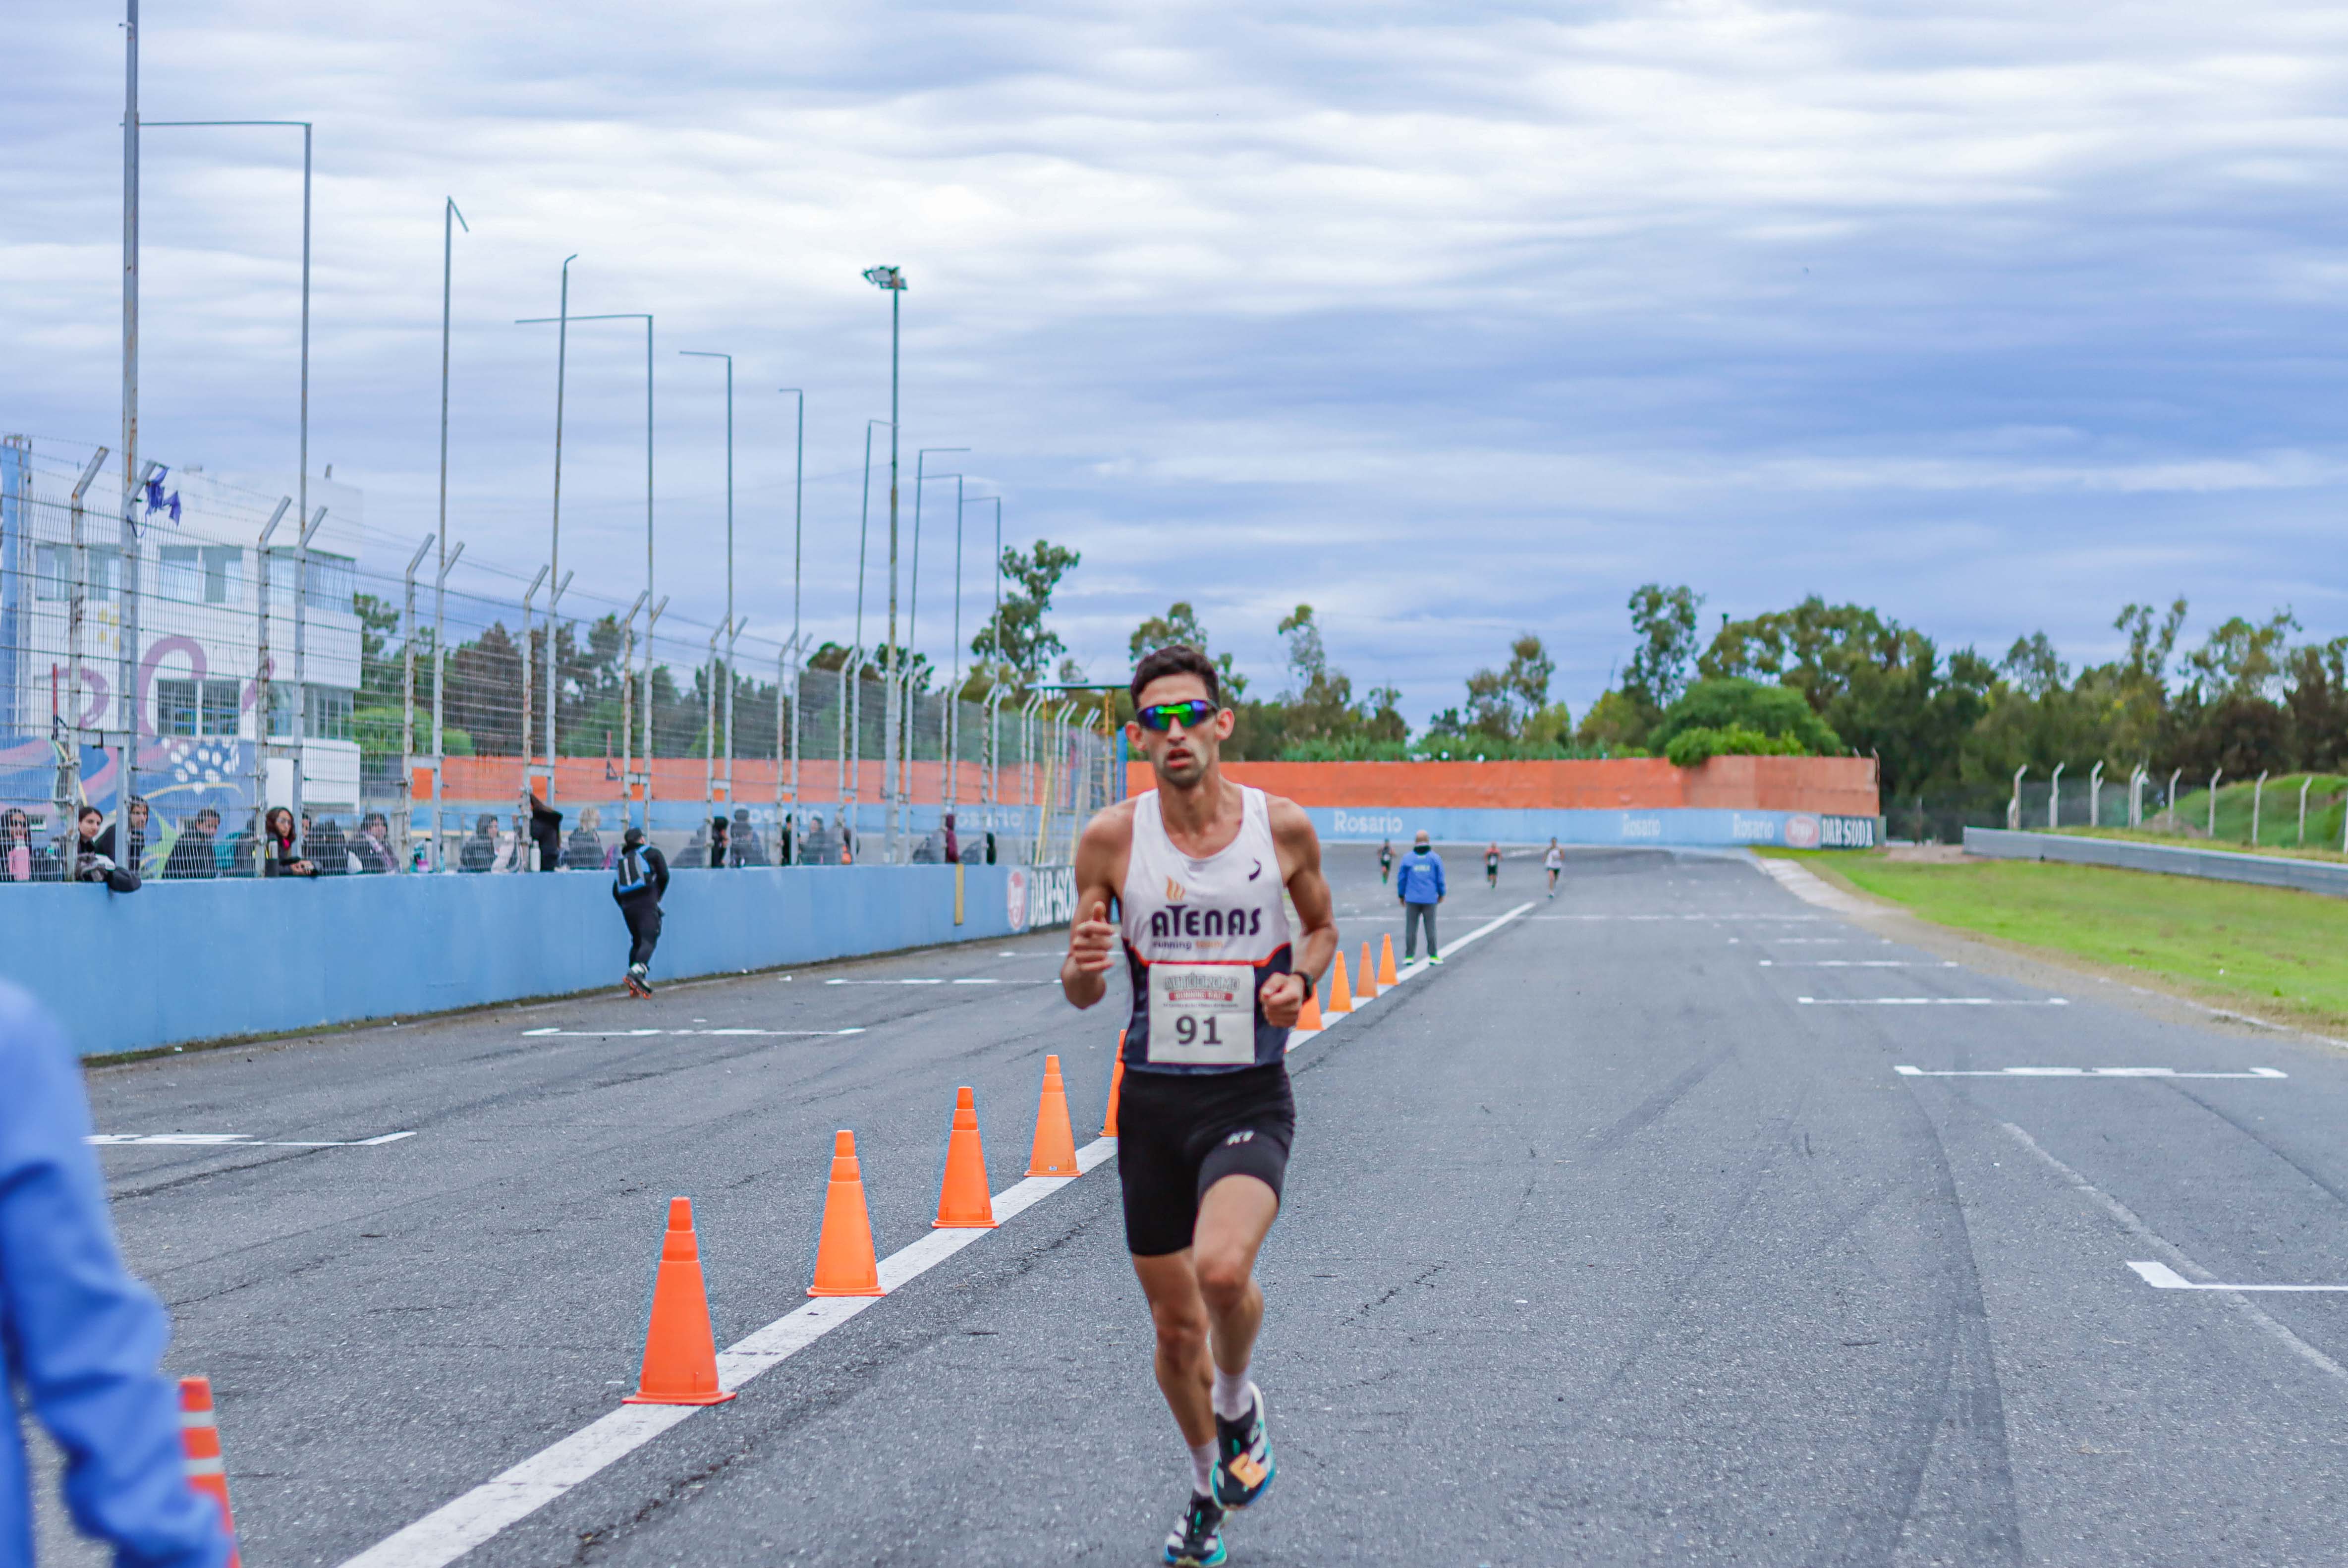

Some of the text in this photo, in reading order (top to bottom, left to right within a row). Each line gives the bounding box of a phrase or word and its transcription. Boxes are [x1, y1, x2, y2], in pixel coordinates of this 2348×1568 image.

[1334, 810, 1403, 833] Rosario
[1623, 813, 1661, 836] Rosario
[1733, 812, 1775, 839] Rosario
[1844, 819, 1873, 846] SODA
[1151, 904, 1261, 936] ATENAS
[1153, 941, 1192, 950] running
[1175, 1015, 1223, 1045] 91
